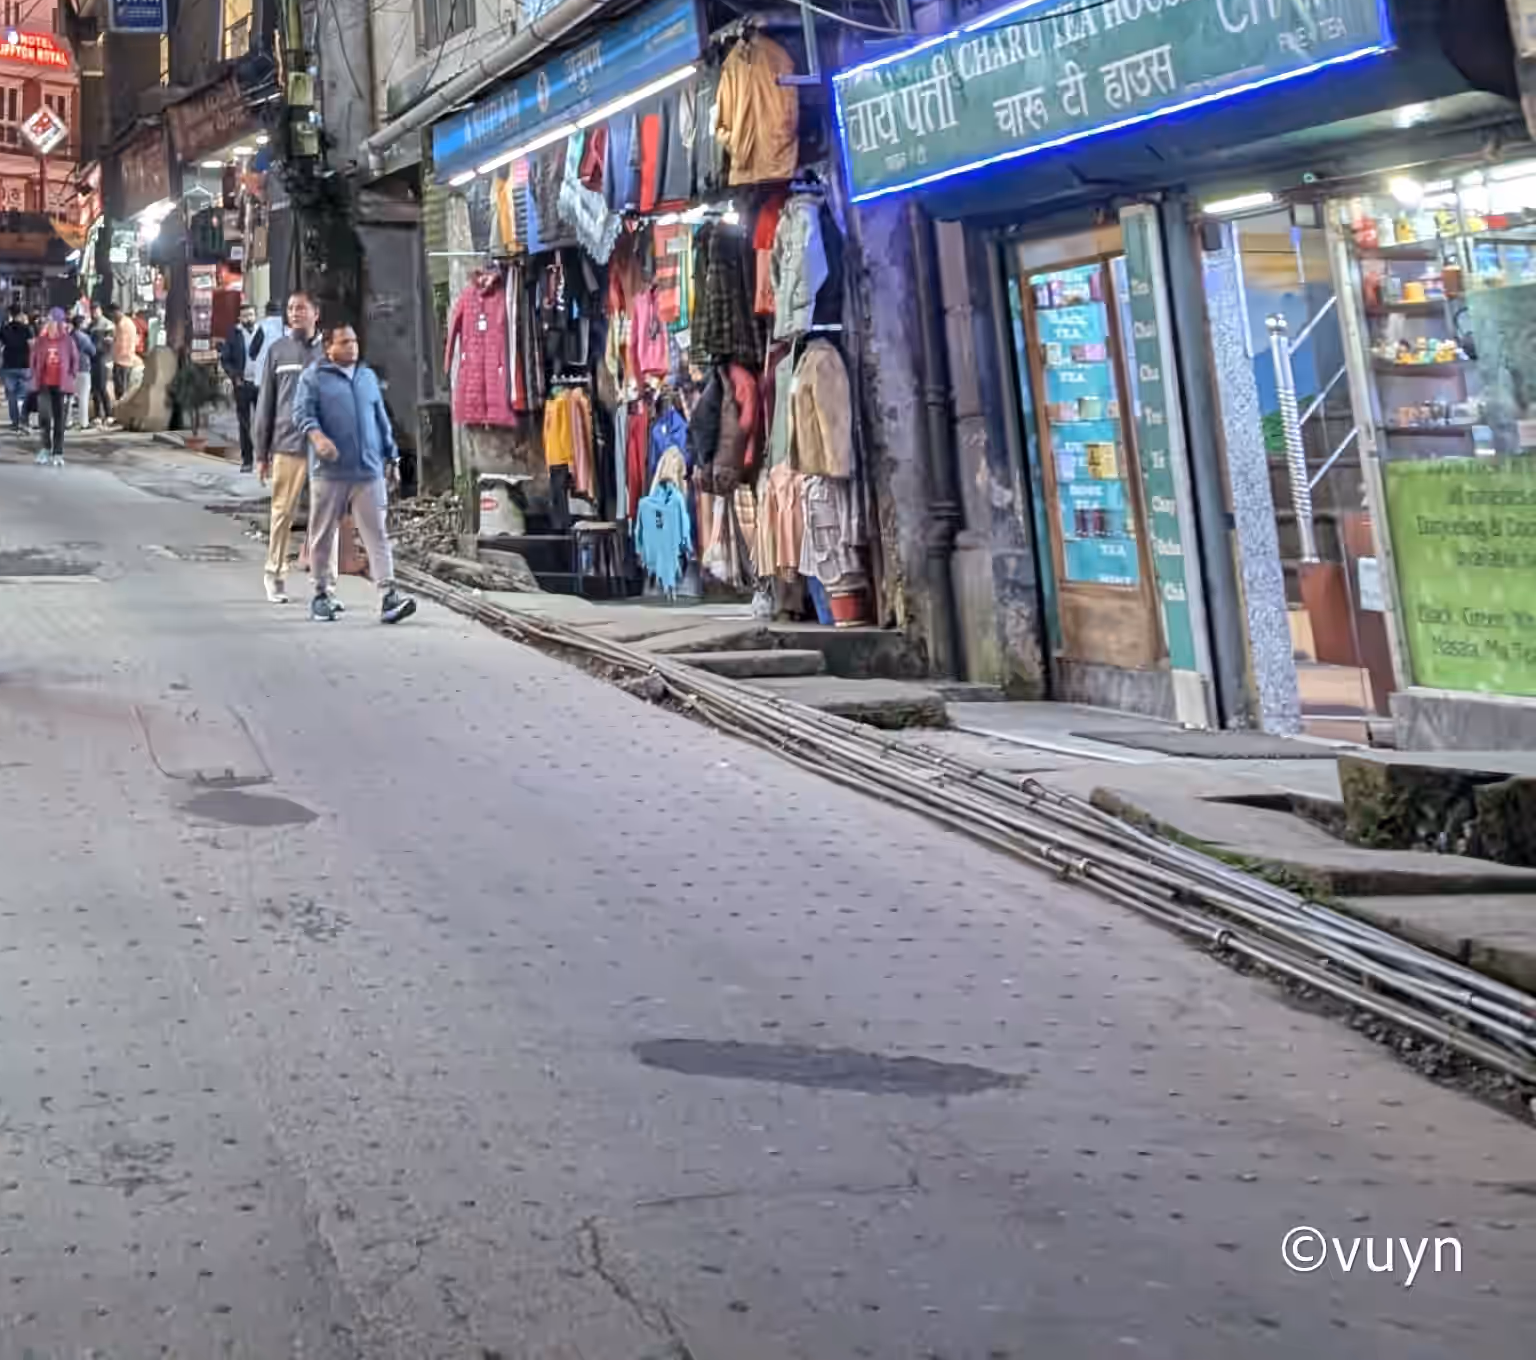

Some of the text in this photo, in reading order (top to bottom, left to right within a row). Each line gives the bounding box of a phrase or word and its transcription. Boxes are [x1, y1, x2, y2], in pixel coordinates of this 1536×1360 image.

[958, 23, 1042, 81] CHARU
[1057, 60, 1089, 117] टी
[1099, 43, 1176, 109] हाउस
